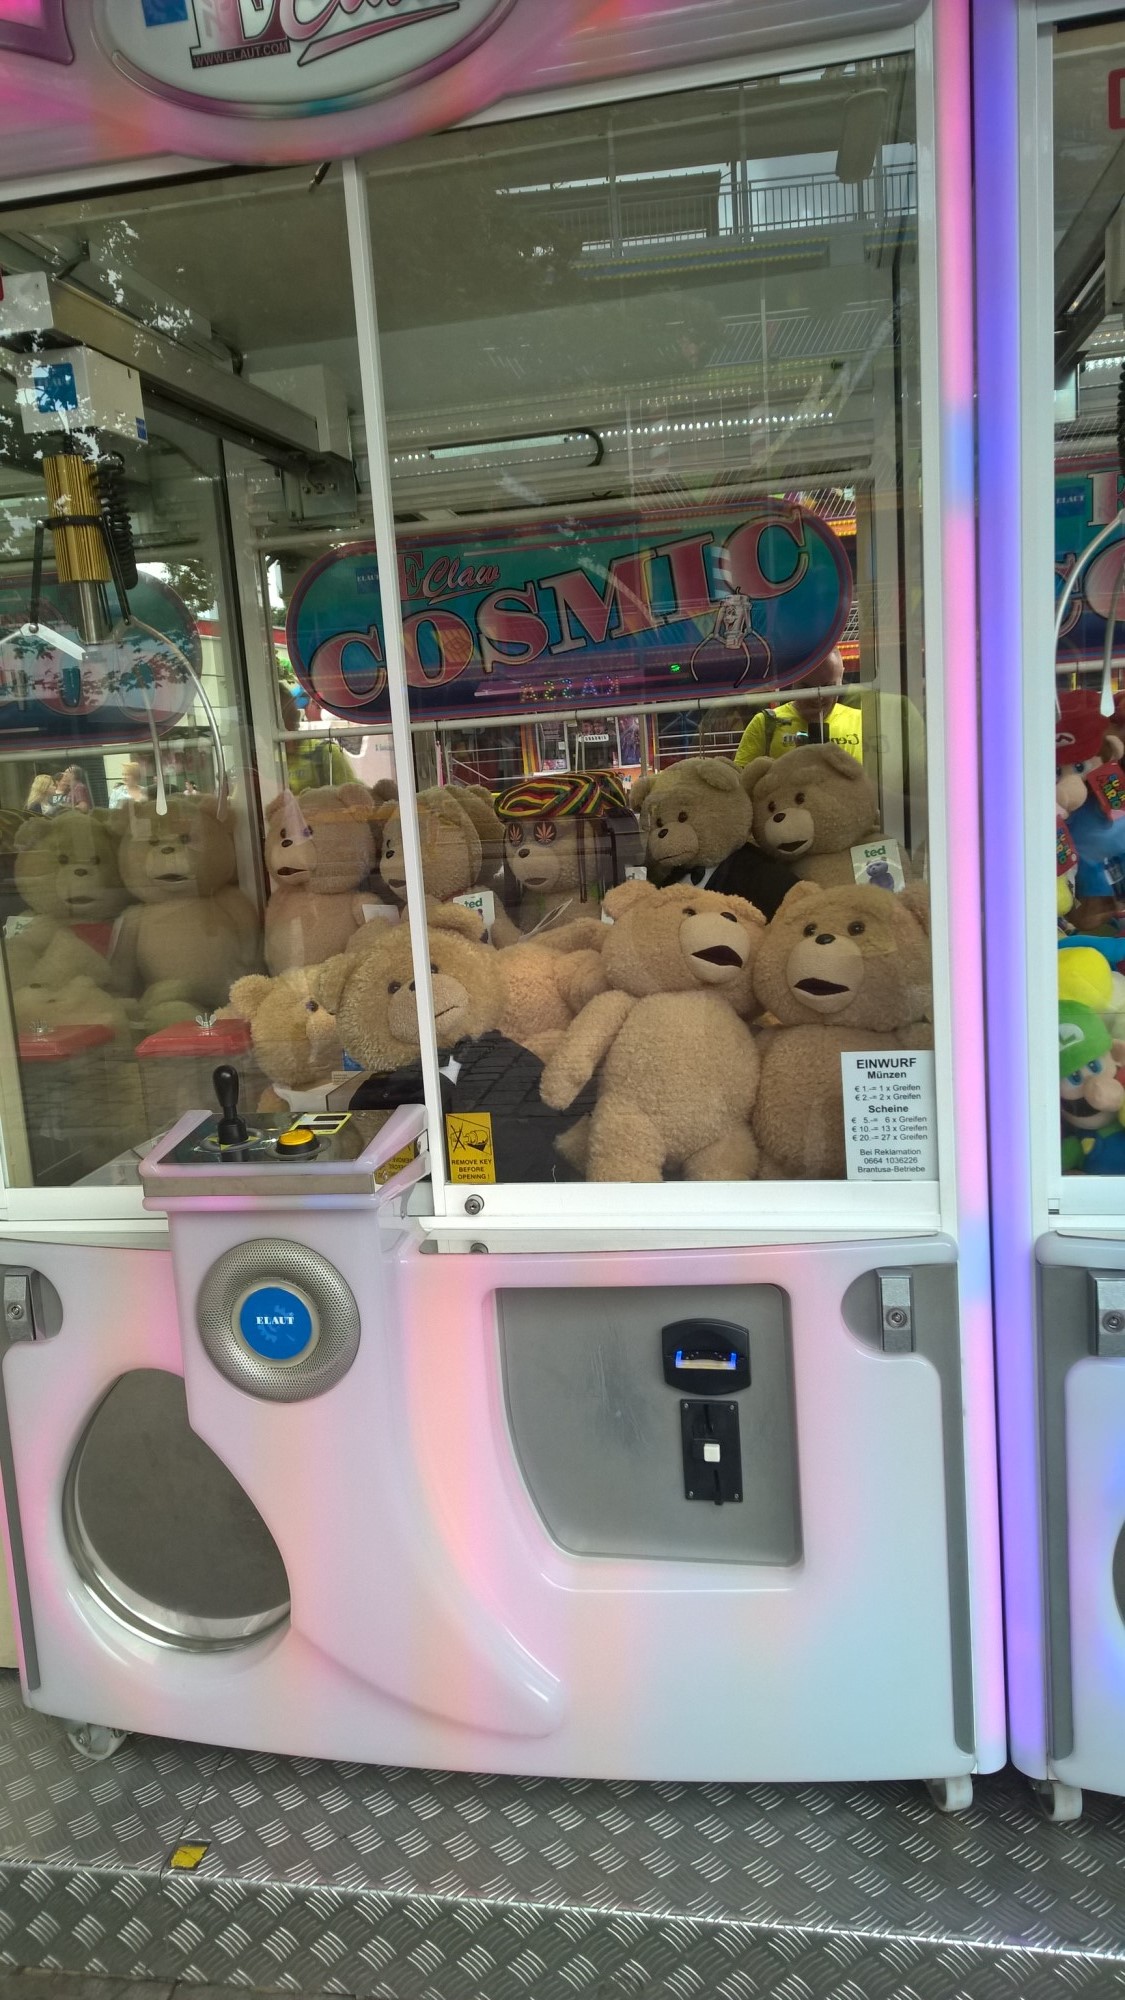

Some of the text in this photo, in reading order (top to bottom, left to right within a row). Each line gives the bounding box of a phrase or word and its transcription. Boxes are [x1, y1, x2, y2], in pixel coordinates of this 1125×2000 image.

[192, 42, 289, 67] WWW.ELAUT.COM
[310, 511, 810, 709] COSMIC
[864, 845, 886, 858] ted
[464, 898, 483, 909] ted
[856, 1058, 917, 1069] EINWURF
[868, 1071, 907, 1079] Münzen
[893, 1084, 921, 1092] Greifen
[868, 1105, 909, 1113] Scheine
[899, 1115, 927, 1123] Greifen
[899, 1124, 928, 1132] Greifen
[255, 1316, 295, 1325] ELAUT
